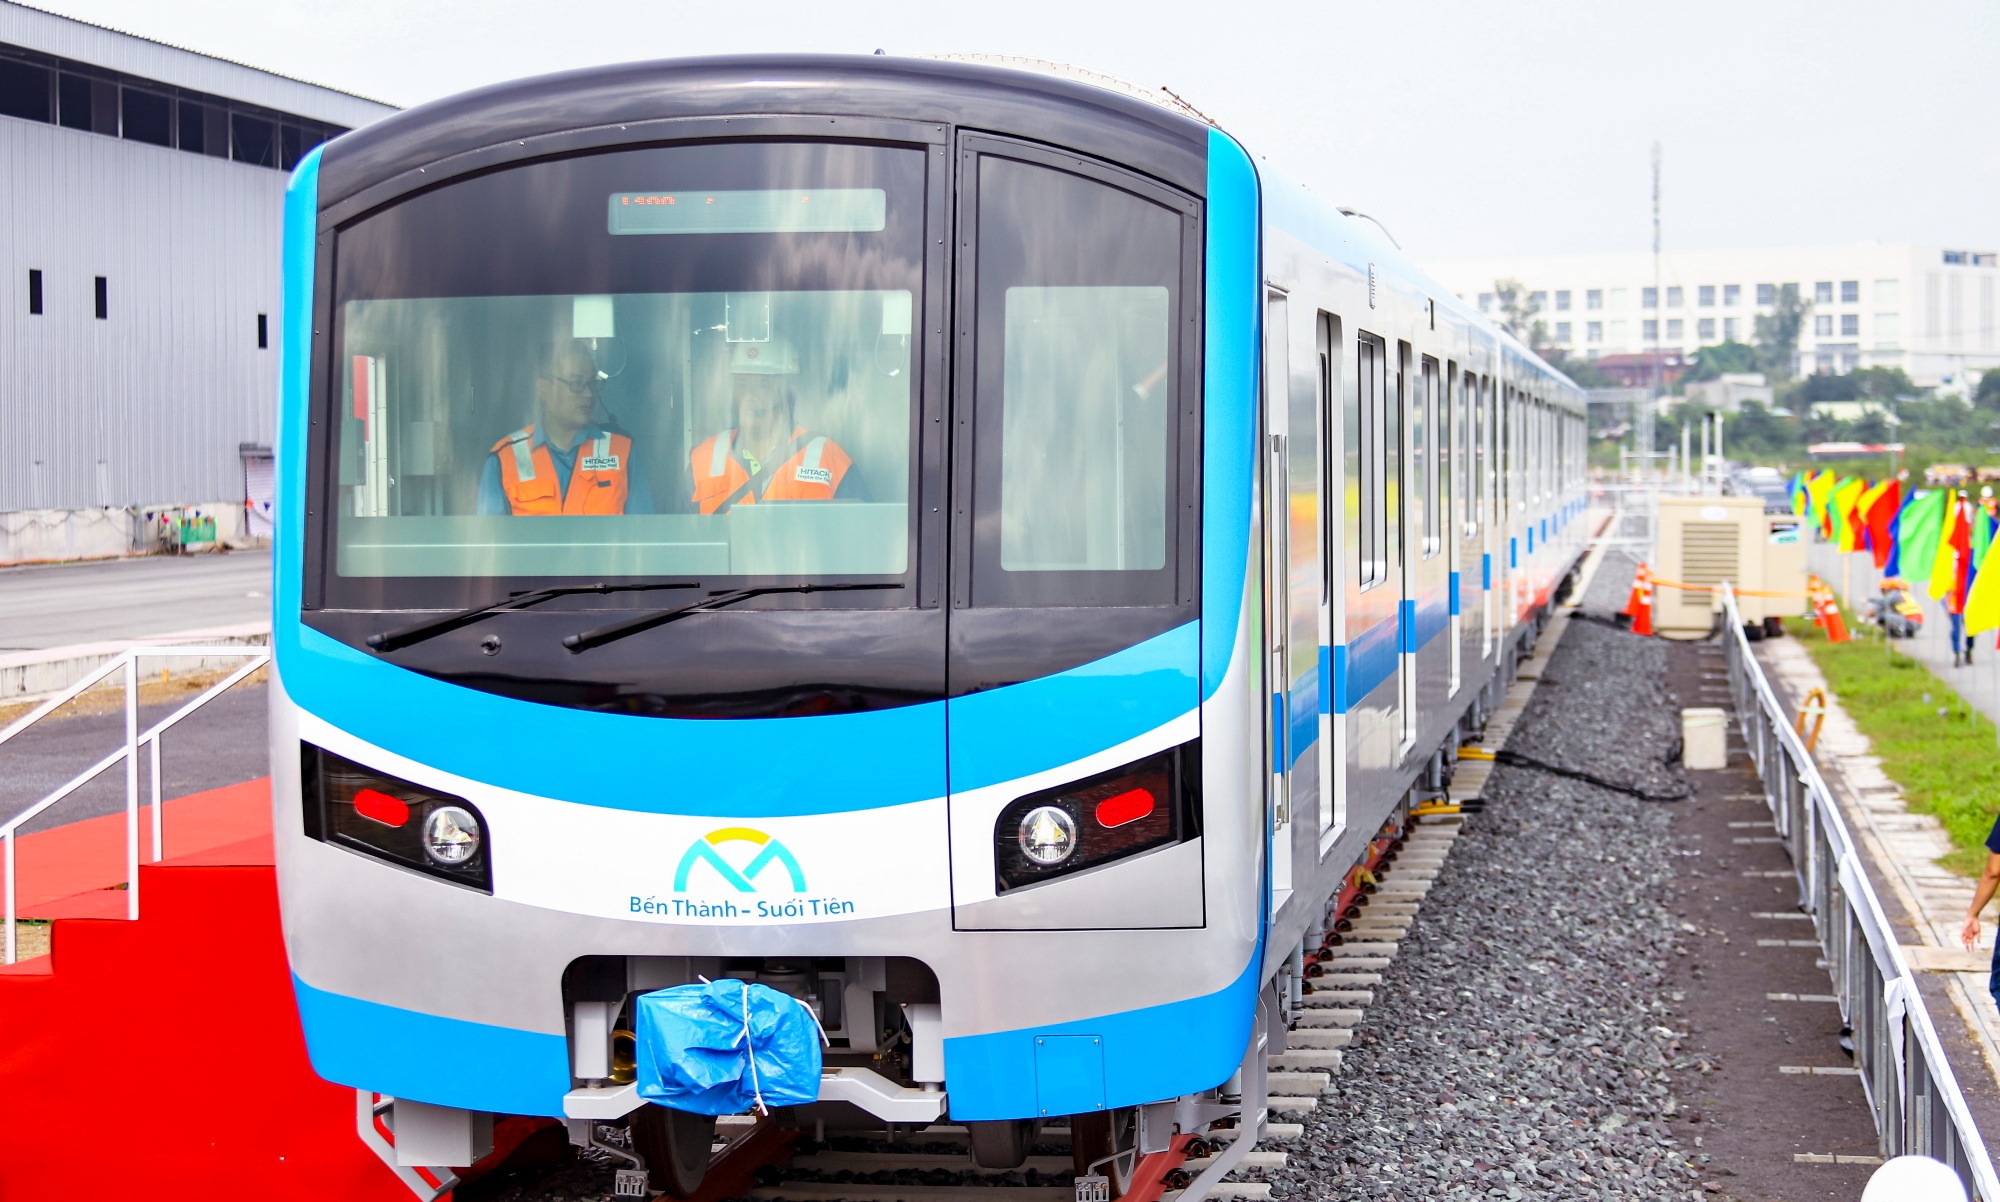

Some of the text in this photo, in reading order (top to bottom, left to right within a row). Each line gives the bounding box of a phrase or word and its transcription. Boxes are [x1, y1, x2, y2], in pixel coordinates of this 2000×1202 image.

[585, 457, 616, 465] HITACHI
[800, 468, 830, 478] HITACH
[630, 895, 668, 915] Bến
[671, 899, 737, 918] Thành
[757, 898, 803, 917] Suối
[808, 897, 854, 916] Tiên
